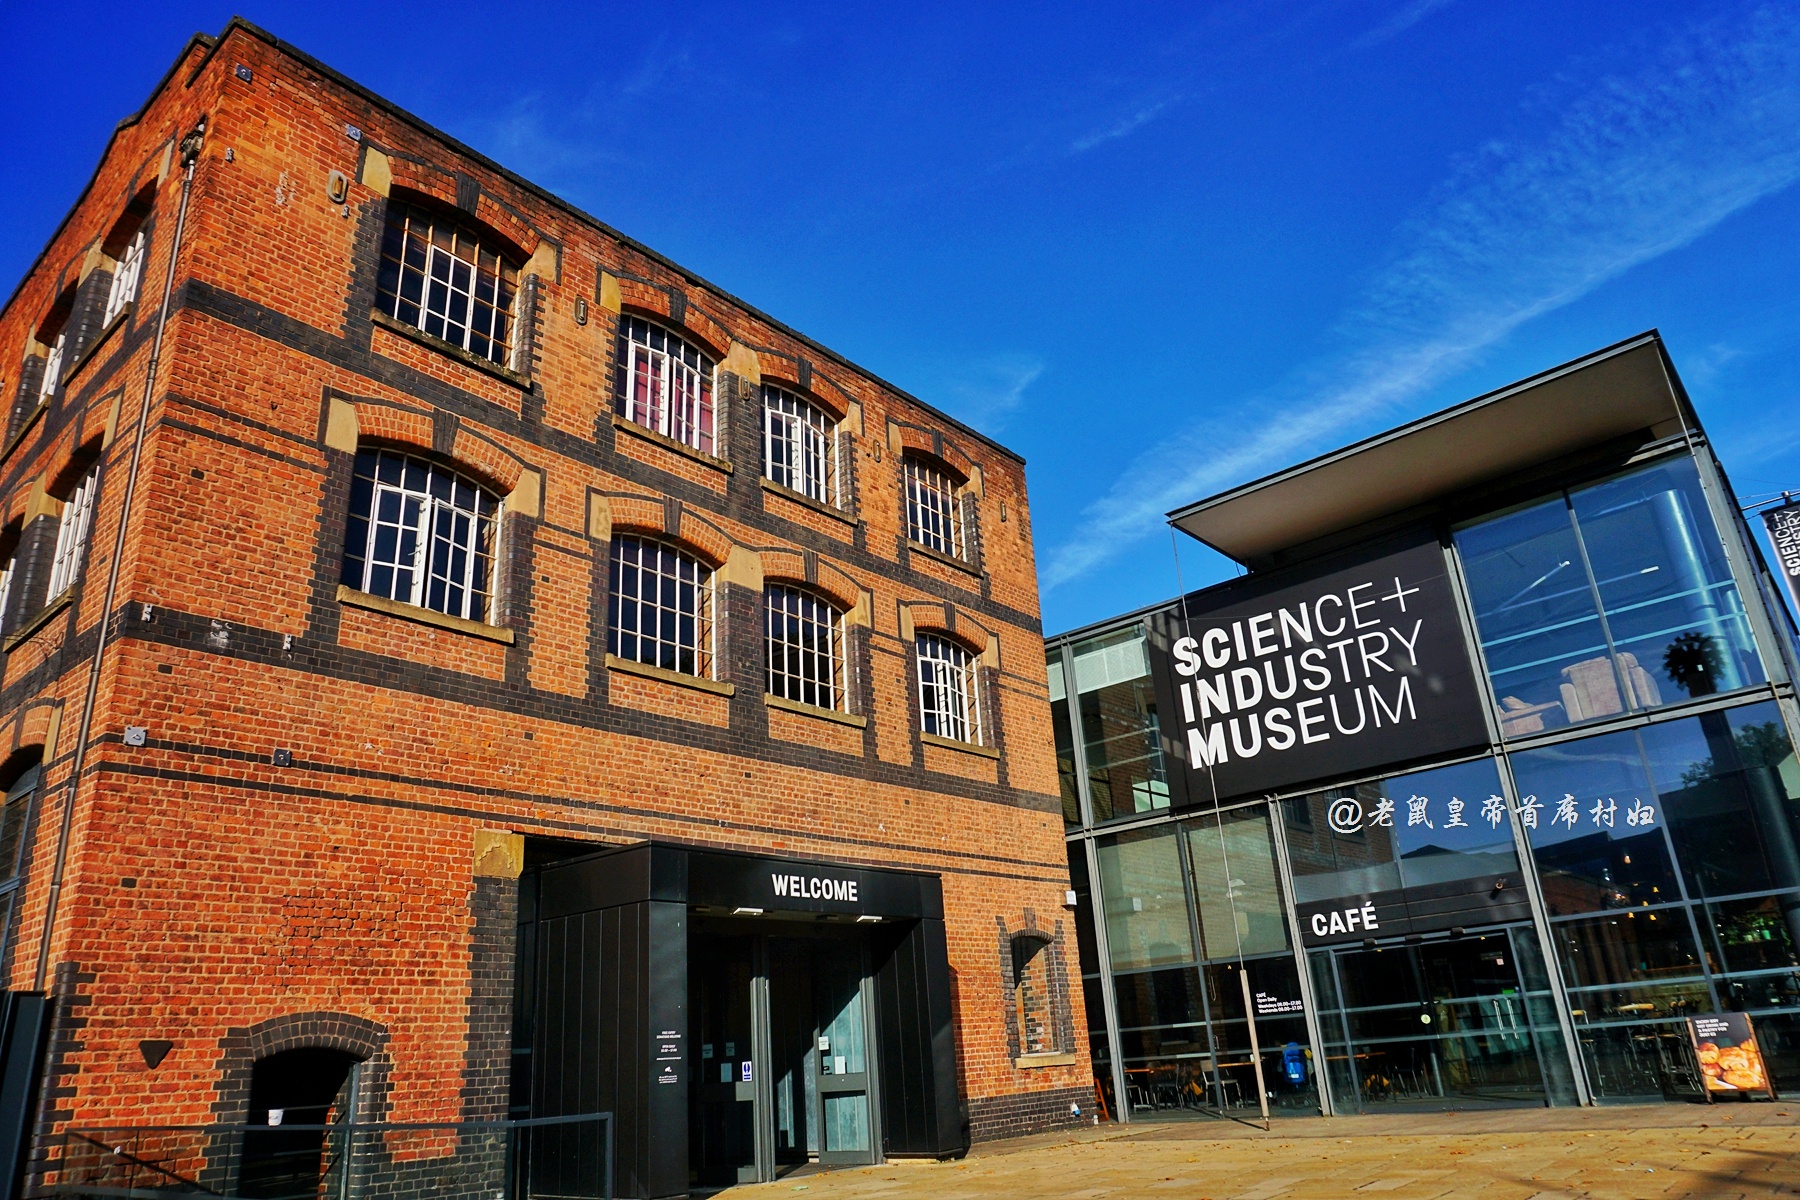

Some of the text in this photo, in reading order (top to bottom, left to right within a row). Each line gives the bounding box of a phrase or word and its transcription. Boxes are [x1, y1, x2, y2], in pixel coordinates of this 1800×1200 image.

[1173, 576, 1420, 676] SCIENCE+
[1180, 619, 1423, 723] INDUSTRY
[1187, 676, 1417, 769] MUSEUM
[771, 873, 858, 901] WELCOME
[1311, 901, 1379, 936] CAFÉ
